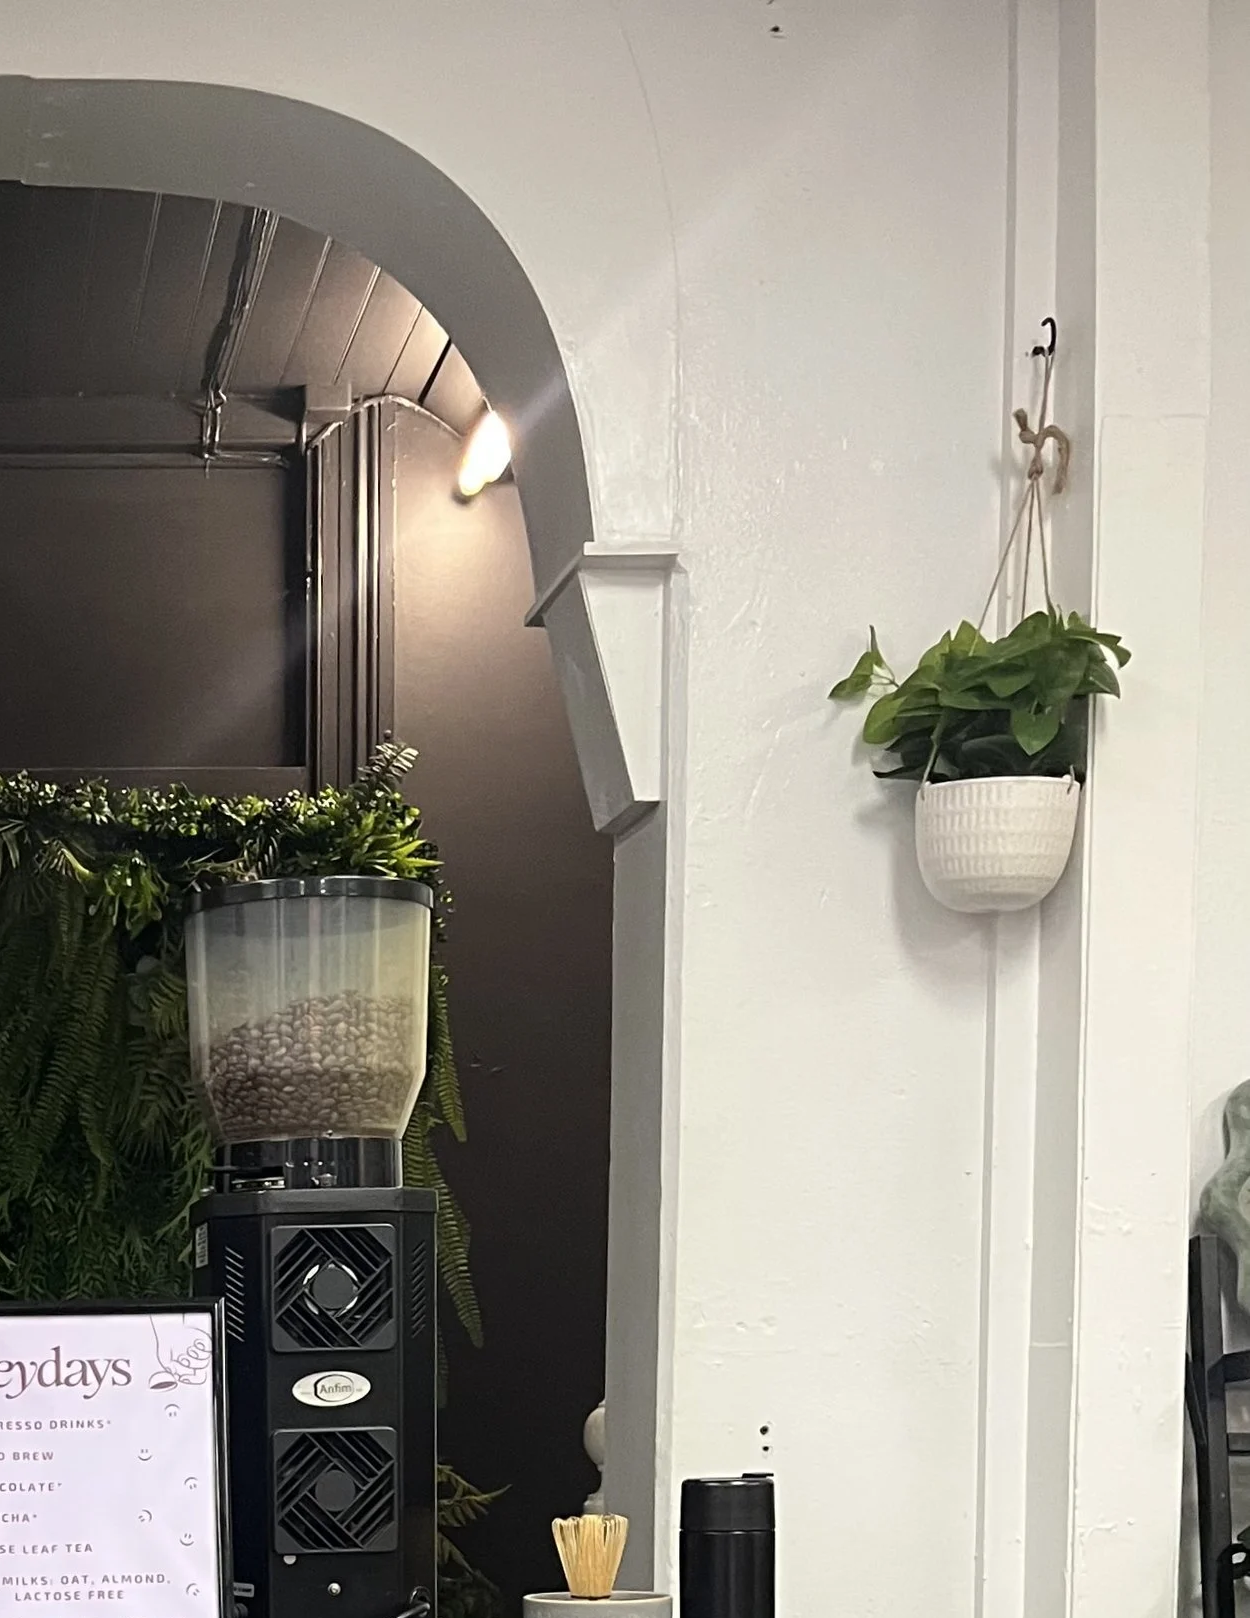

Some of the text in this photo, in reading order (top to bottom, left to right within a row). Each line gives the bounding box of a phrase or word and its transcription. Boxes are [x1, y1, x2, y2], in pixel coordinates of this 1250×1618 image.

[319, 1383, 352, 1394] Anfim
[12, 1451, 54, 1461] BREW
[22, 1544, 58, 1554] LEAF
[65, 1543, 93, 1553] TEA
[60, 1574, 95, 1585] OAT,
[14, 1590, 125, 1601] LACTOSE FREE
